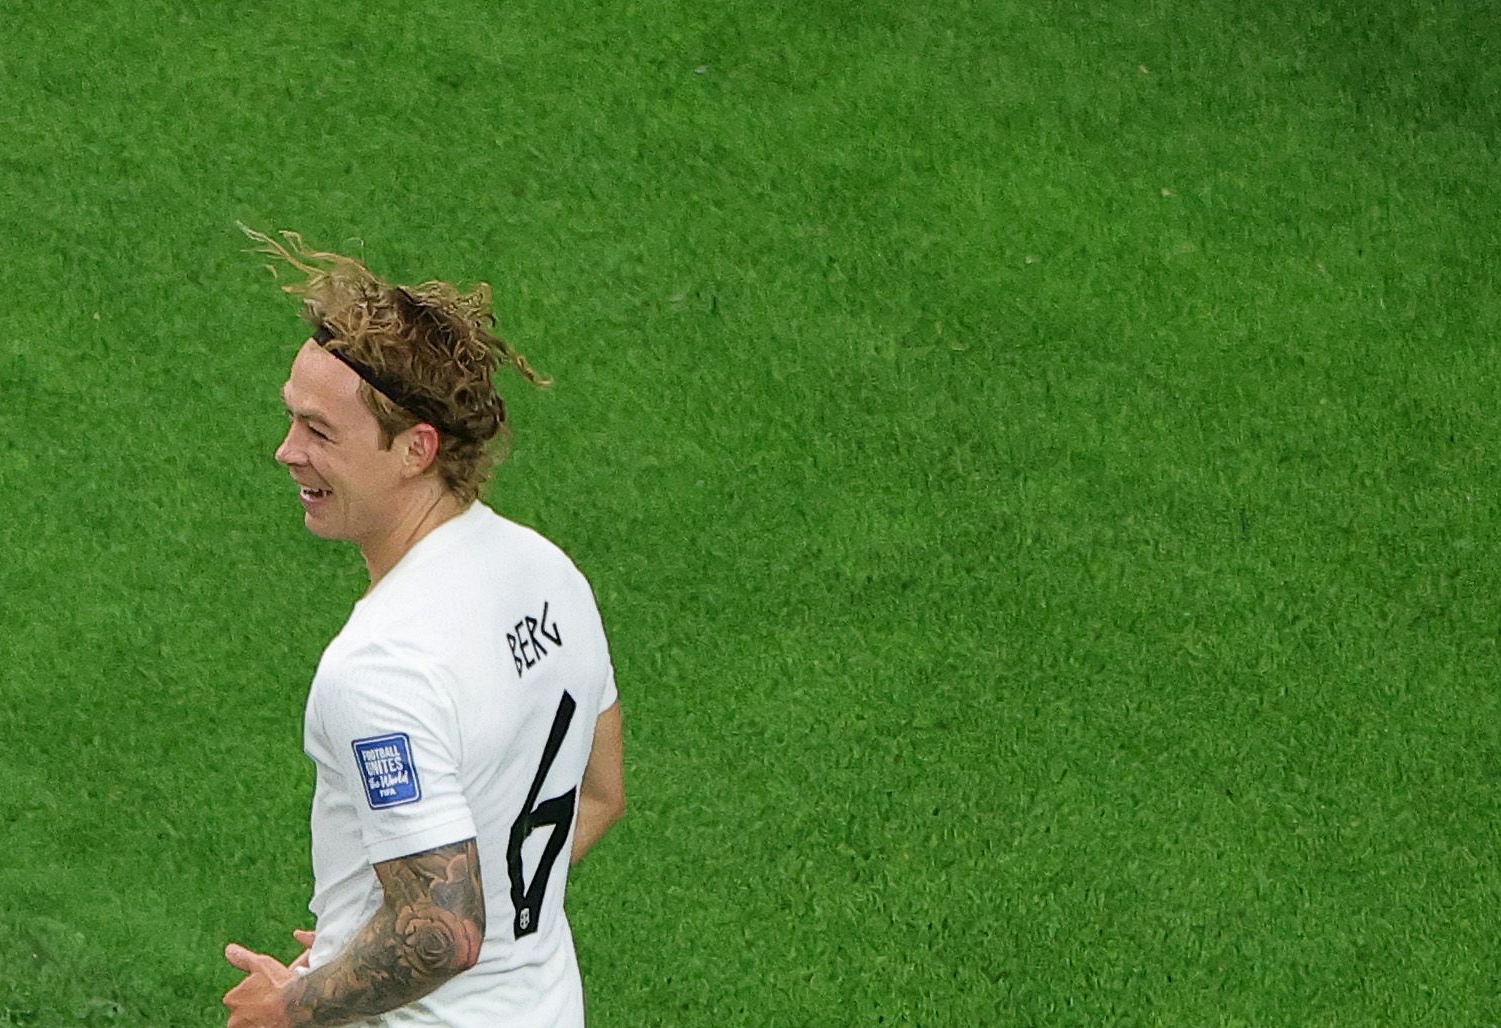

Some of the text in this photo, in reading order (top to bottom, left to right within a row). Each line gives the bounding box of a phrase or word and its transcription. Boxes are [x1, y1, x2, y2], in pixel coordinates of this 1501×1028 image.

[506, 601, 563, 678] BERG
[361, 745, 401, 761] FOOTBALL
[365, 757, 404, 776] UNITES
[506, 689, 578, 940] 6
